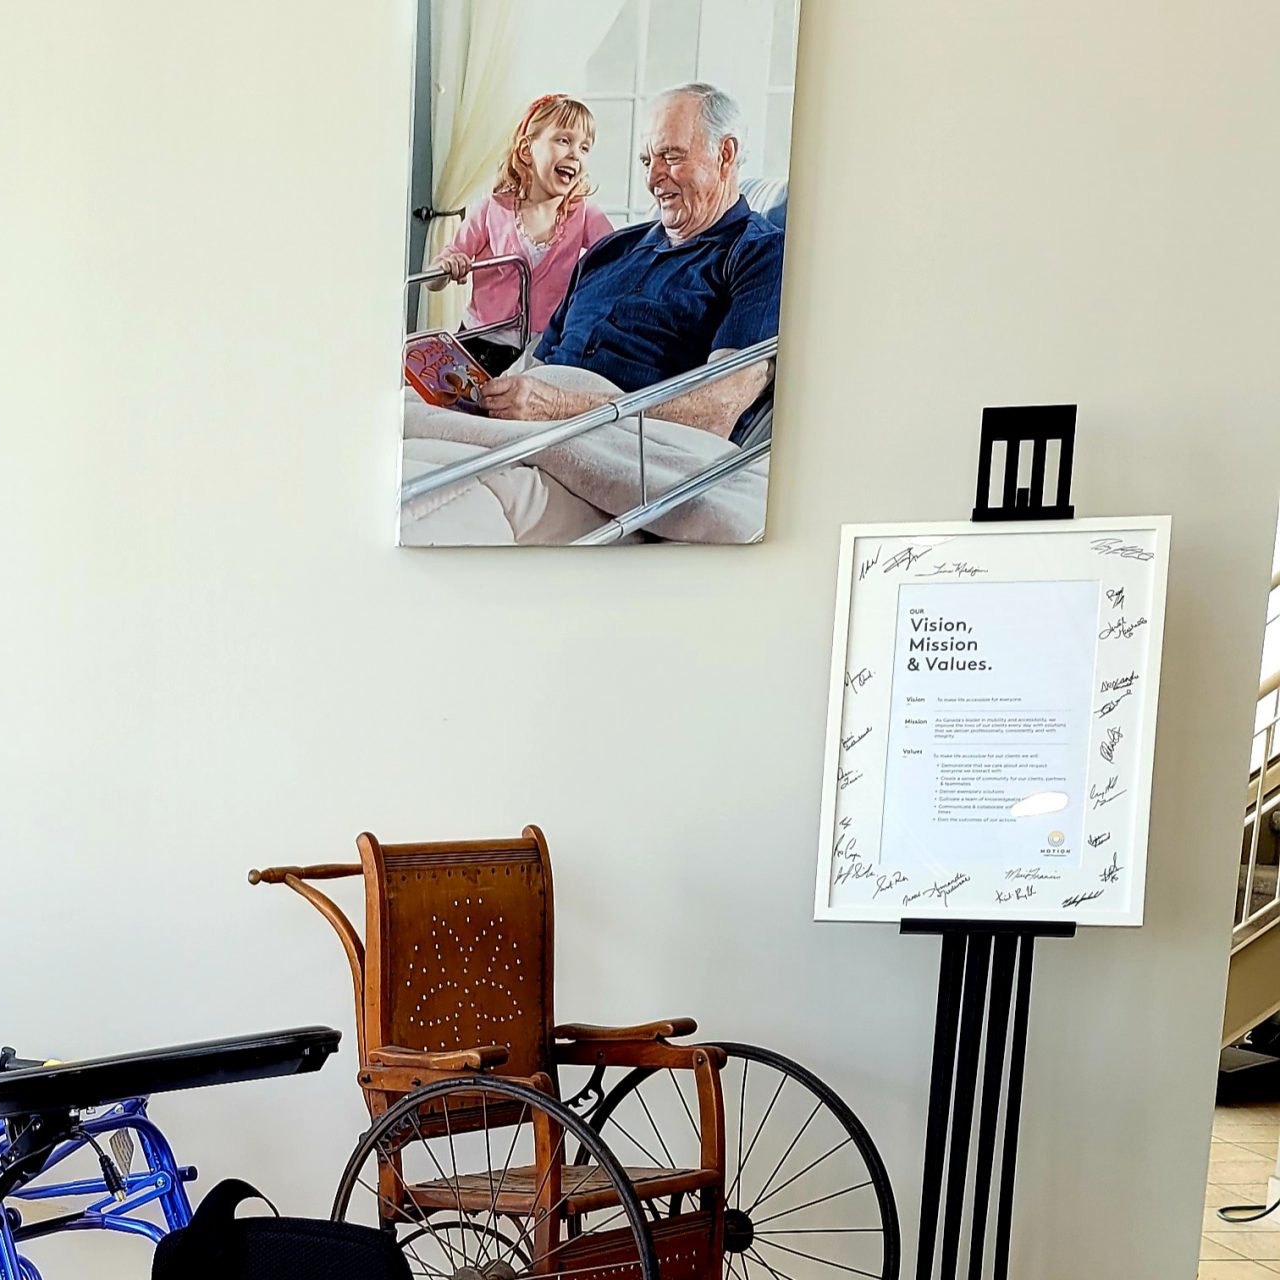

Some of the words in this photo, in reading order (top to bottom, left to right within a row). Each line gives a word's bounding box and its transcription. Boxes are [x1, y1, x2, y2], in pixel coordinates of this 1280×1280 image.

[910, 617, 973, 634] Vision,
[909, 636, 978, 652] Mission
[907, 657, 920, 671] &
[925, 657, 992, 671] Values.
